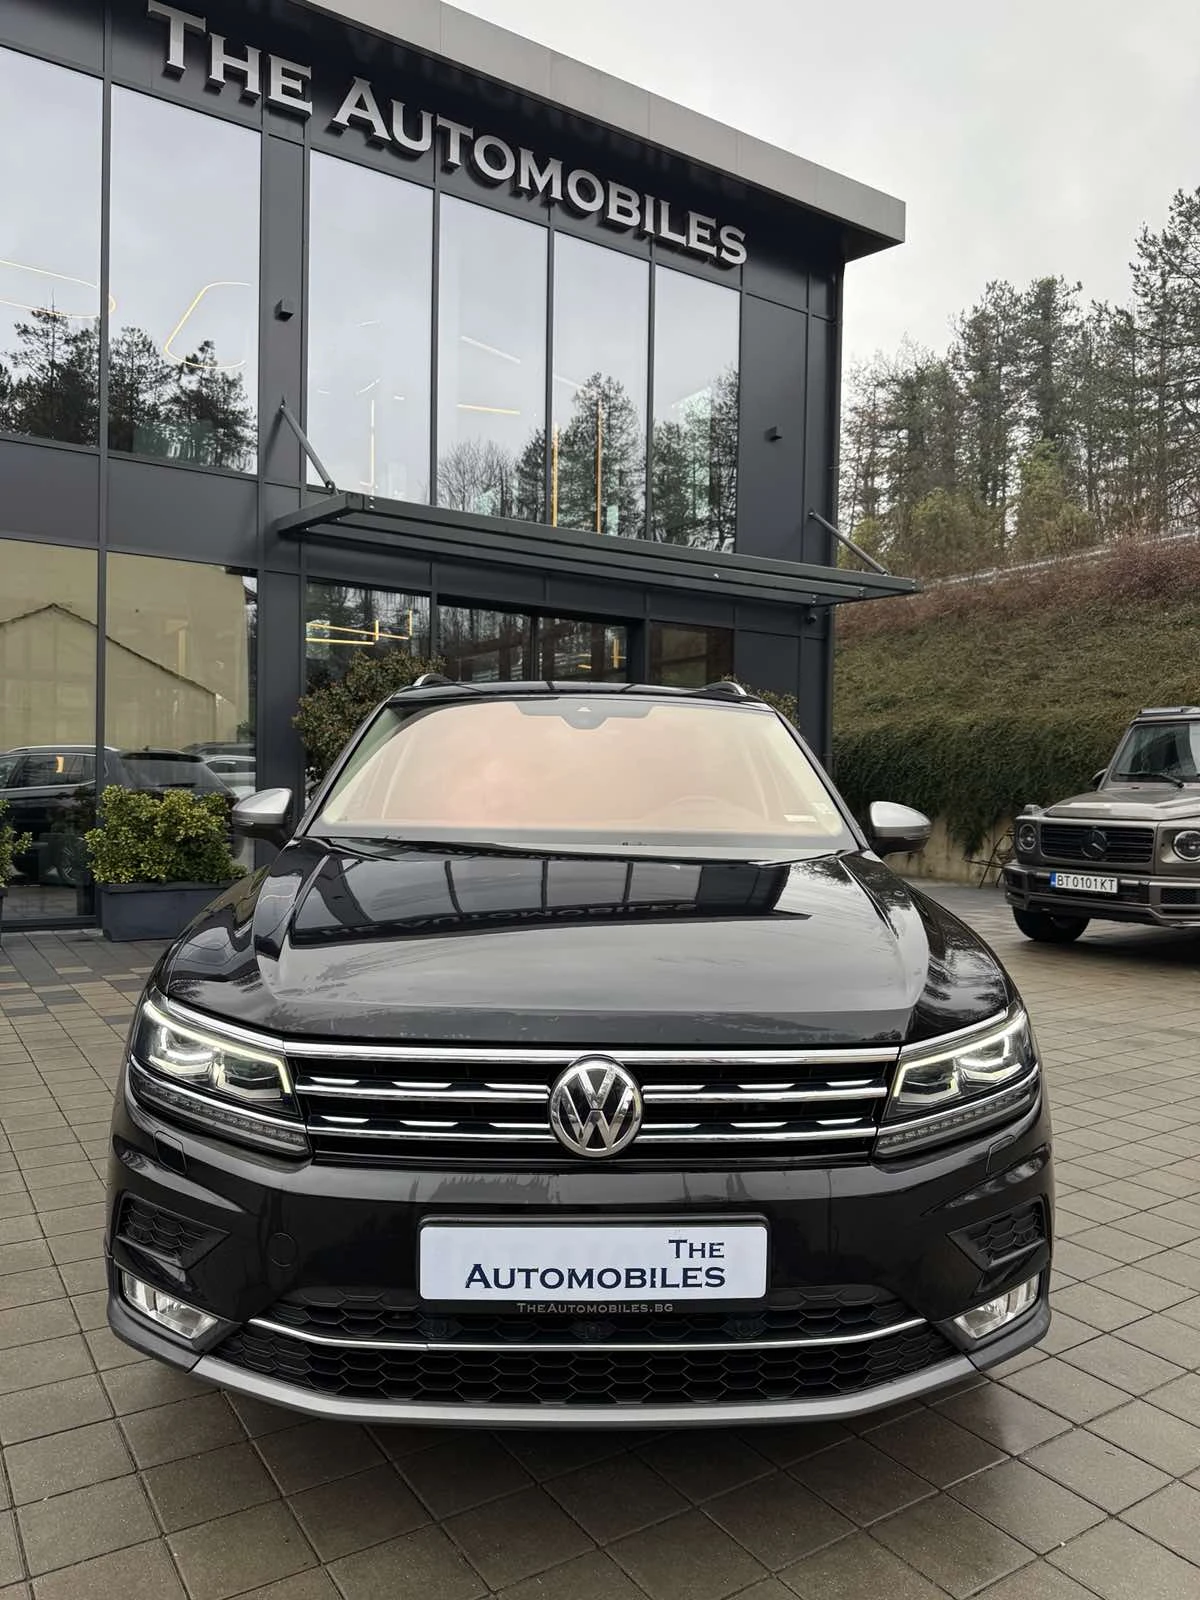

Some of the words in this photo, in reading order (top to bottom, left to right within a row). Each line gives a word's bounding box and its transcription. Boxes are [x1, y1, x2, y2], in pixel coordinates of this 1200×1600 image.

[148, 0, 312, 116] THE
[332, 76, 748, 266] AUTOMOBILES
[668, 1239, 725, 1259] THE
[464, 1263, 727, 1290] AUTOMOBILES
